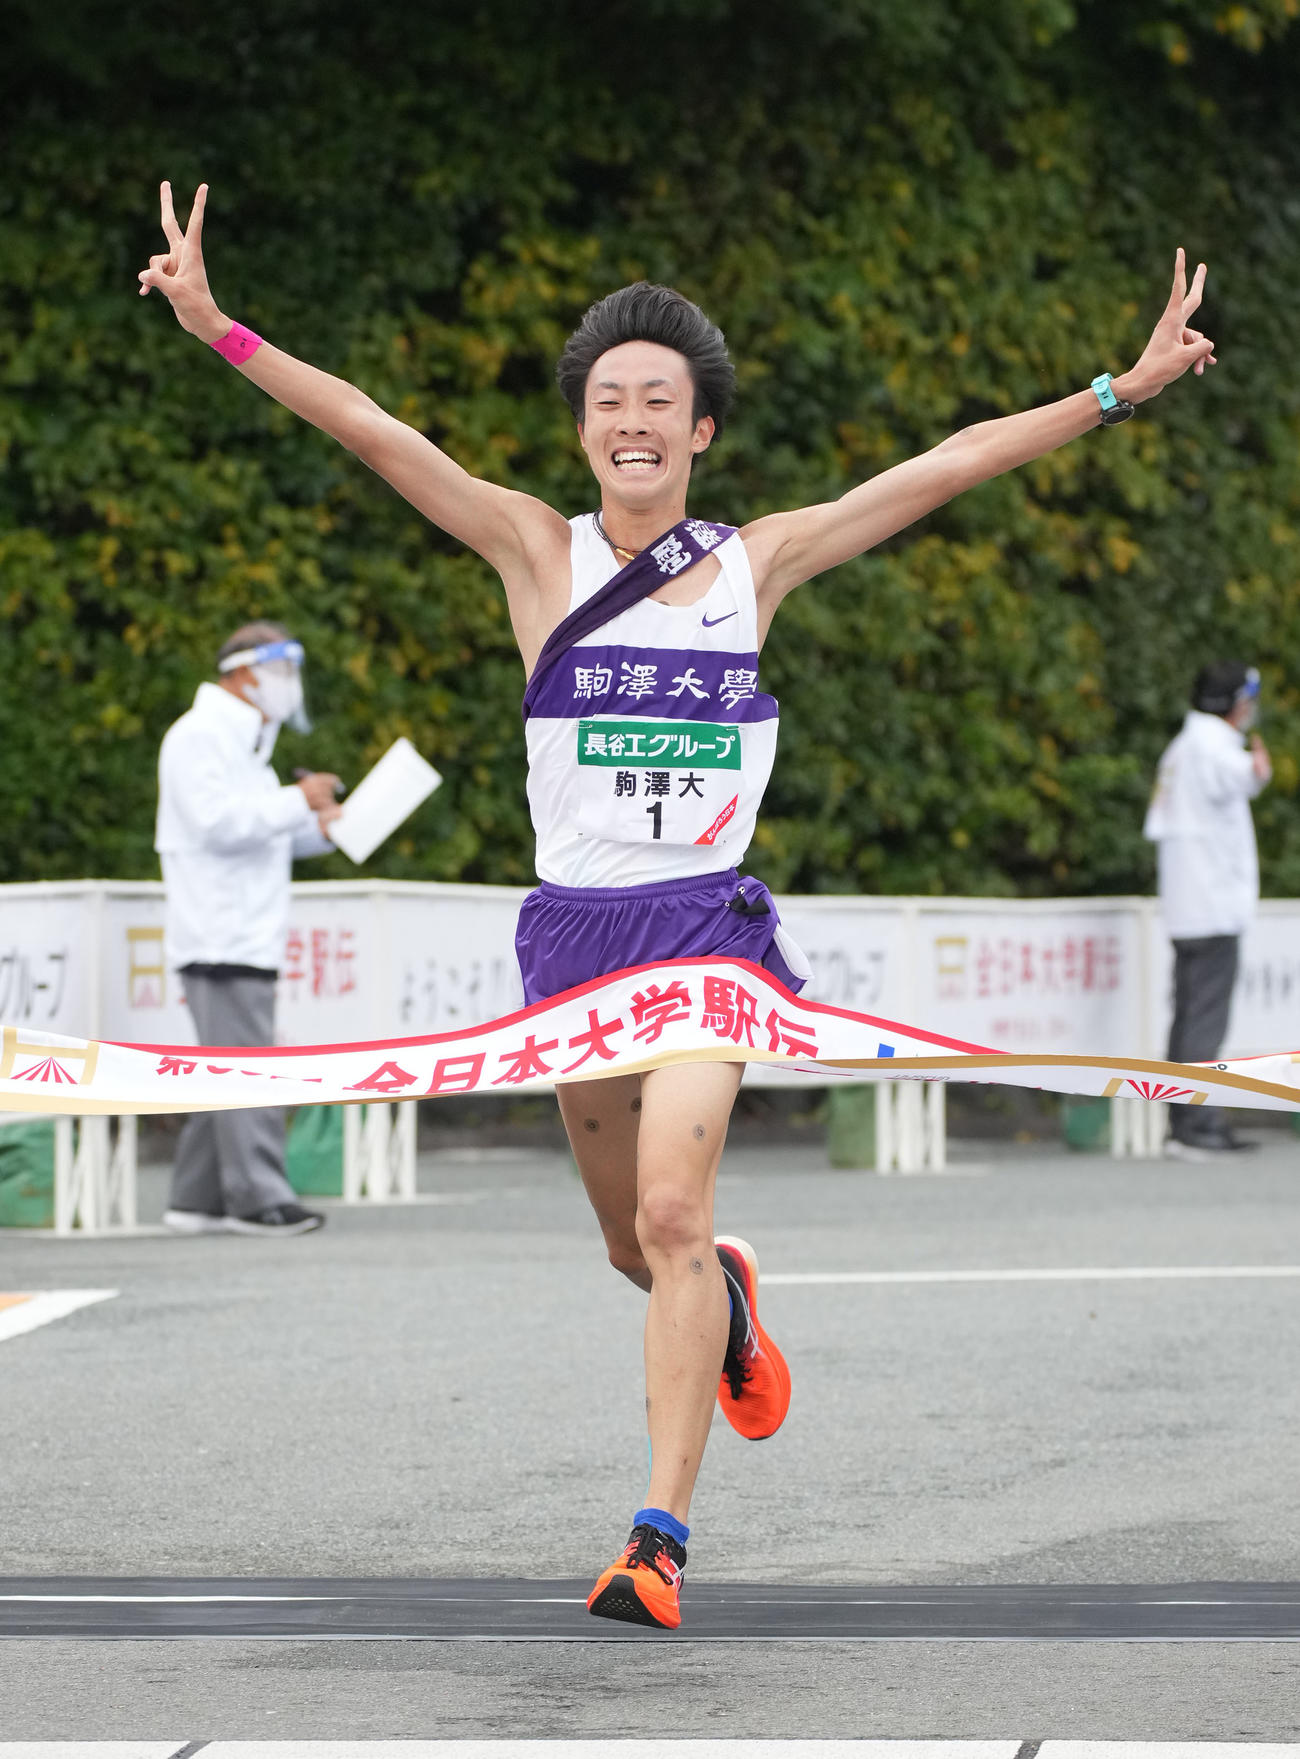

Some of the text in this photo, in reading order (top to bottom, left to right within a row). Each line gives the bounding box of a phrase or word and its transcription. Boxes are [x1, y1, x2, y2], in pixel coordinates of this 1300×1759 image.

[573, 662, 758, 711] 駒澤大學
[584, 732, 736, 759] 長谷工グループ
[614, 770, 705, 798] 駒澤大
[646, 801, 662, 840] 1
[342, 975, 819, 1095] 全日本大学駅伝
